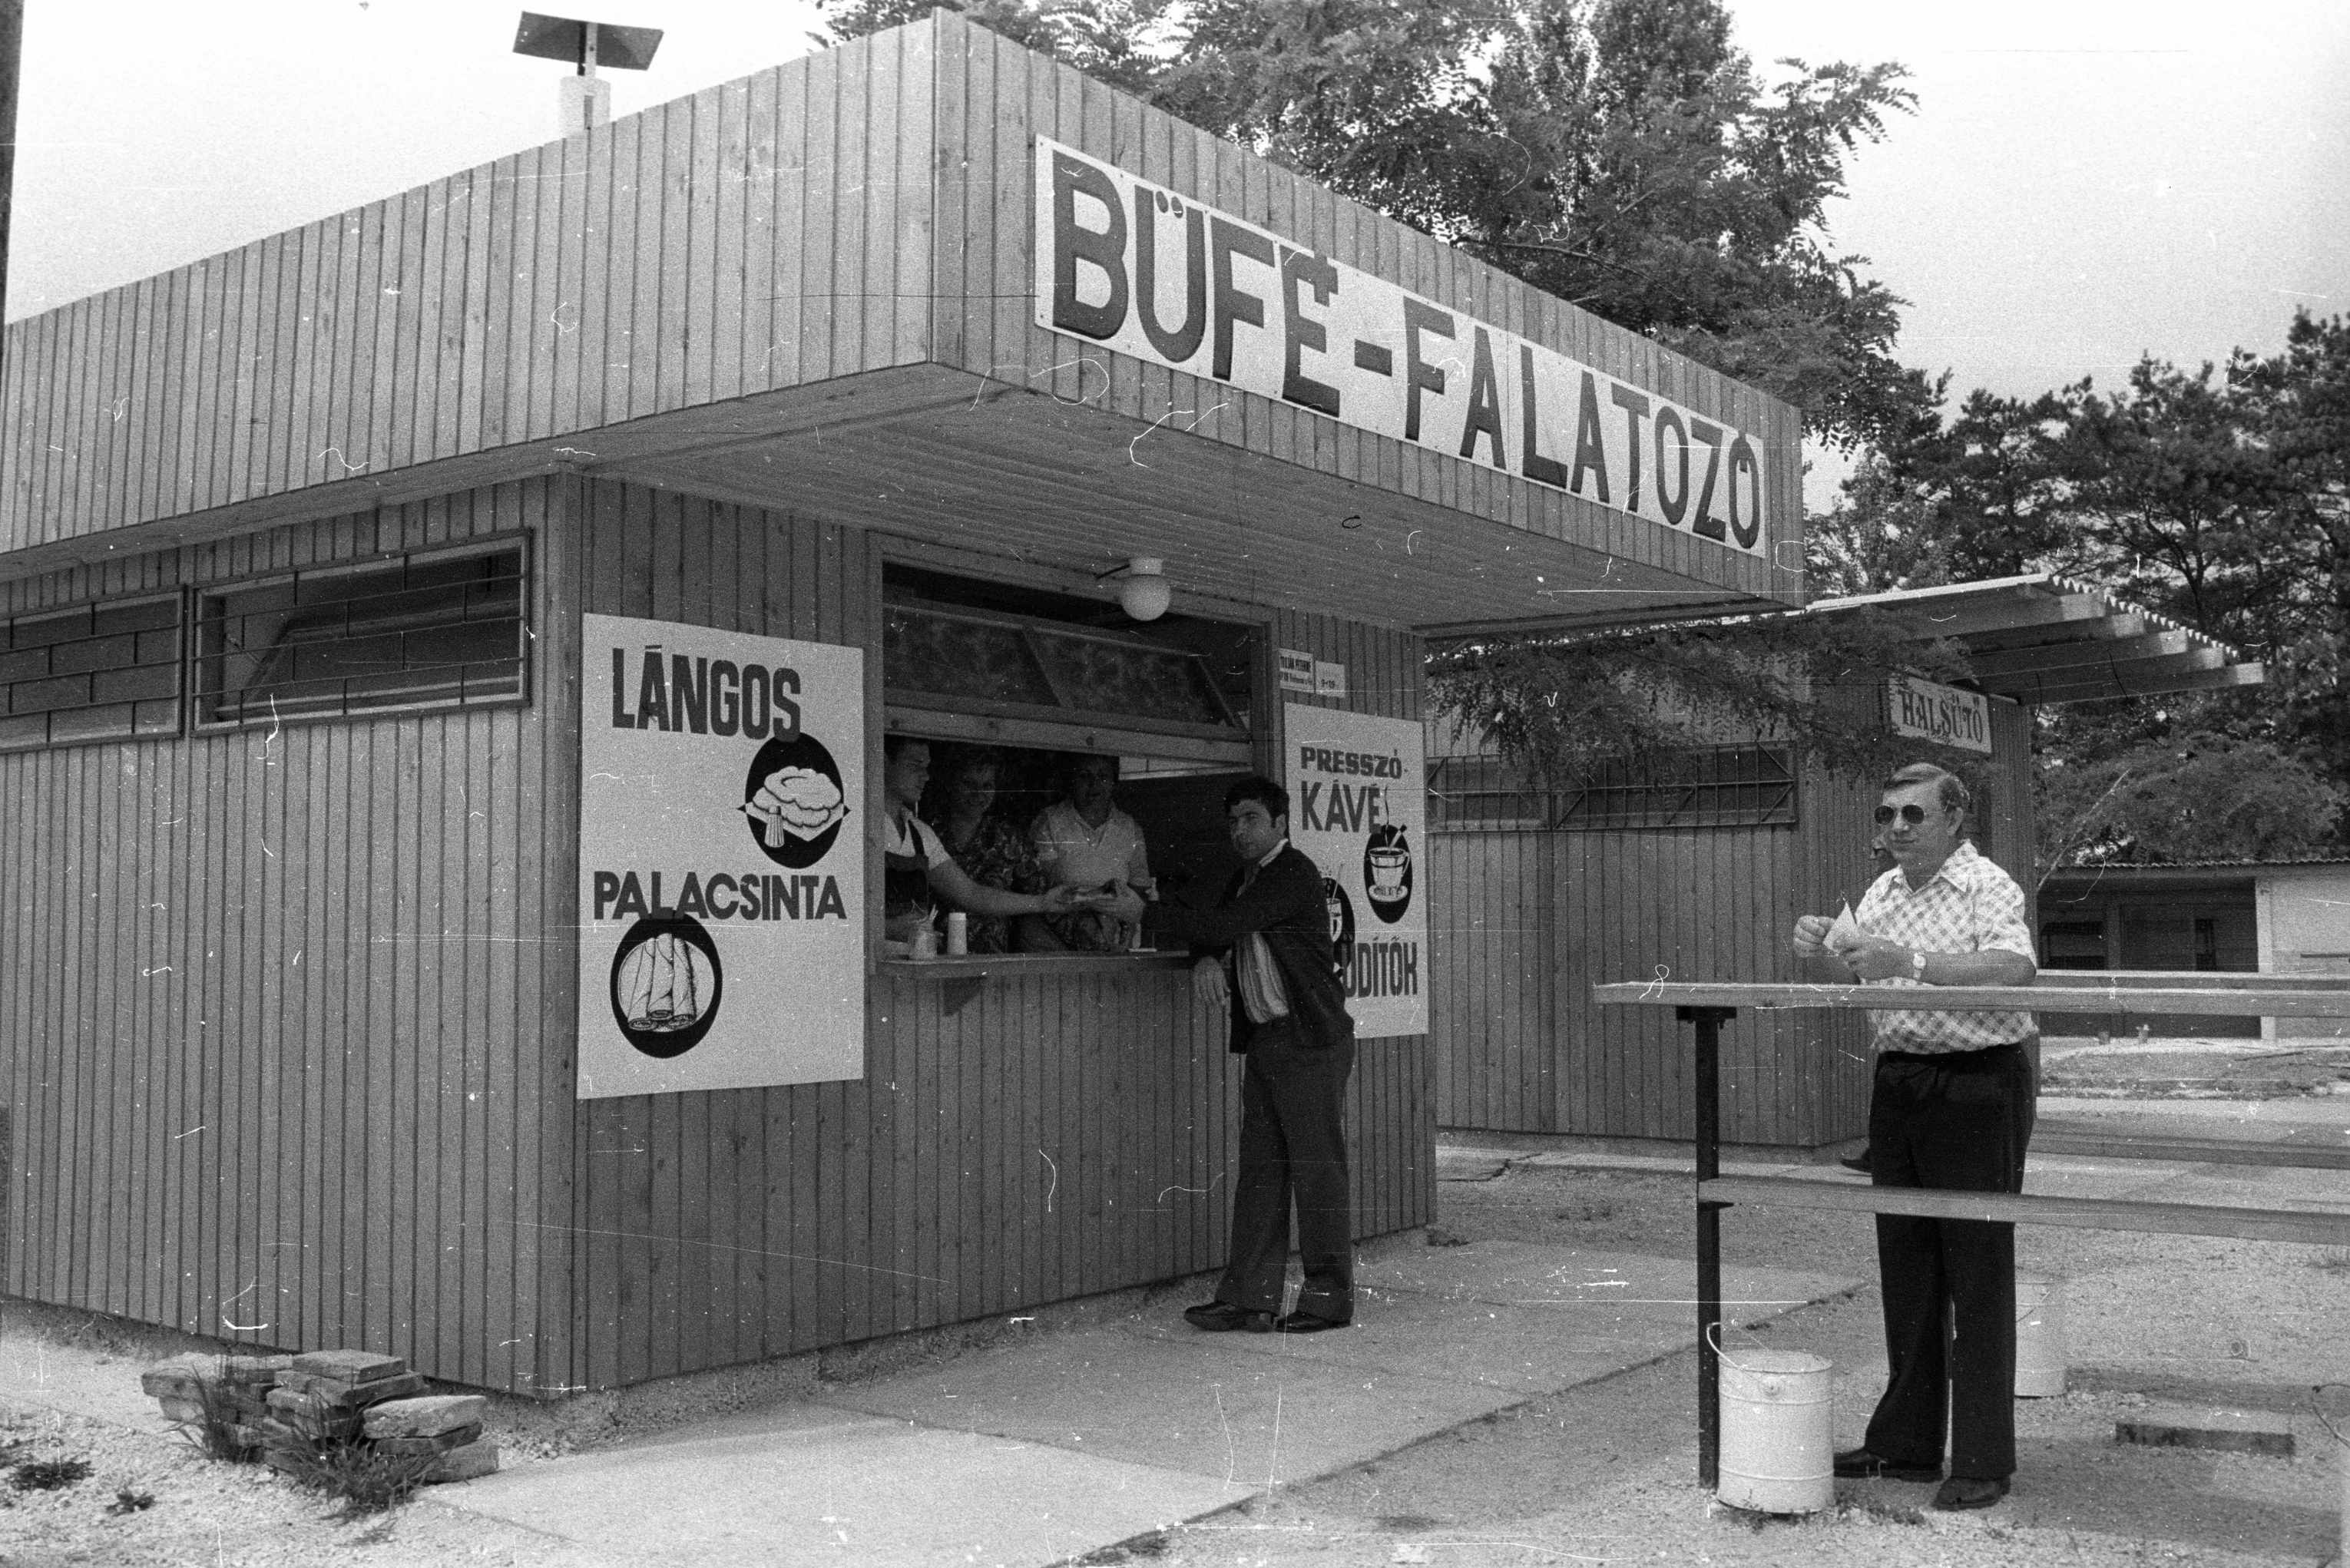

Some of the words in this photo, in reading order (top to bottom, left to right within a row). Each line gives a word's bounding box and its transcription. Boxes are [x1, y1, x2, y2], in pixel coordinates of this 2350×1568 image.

[612, 645, 801, 742] LÁNGOS
[1301, 779, 1381, 833] KÁVÉ
[593, 871, 846, 921] PALACSINTA
